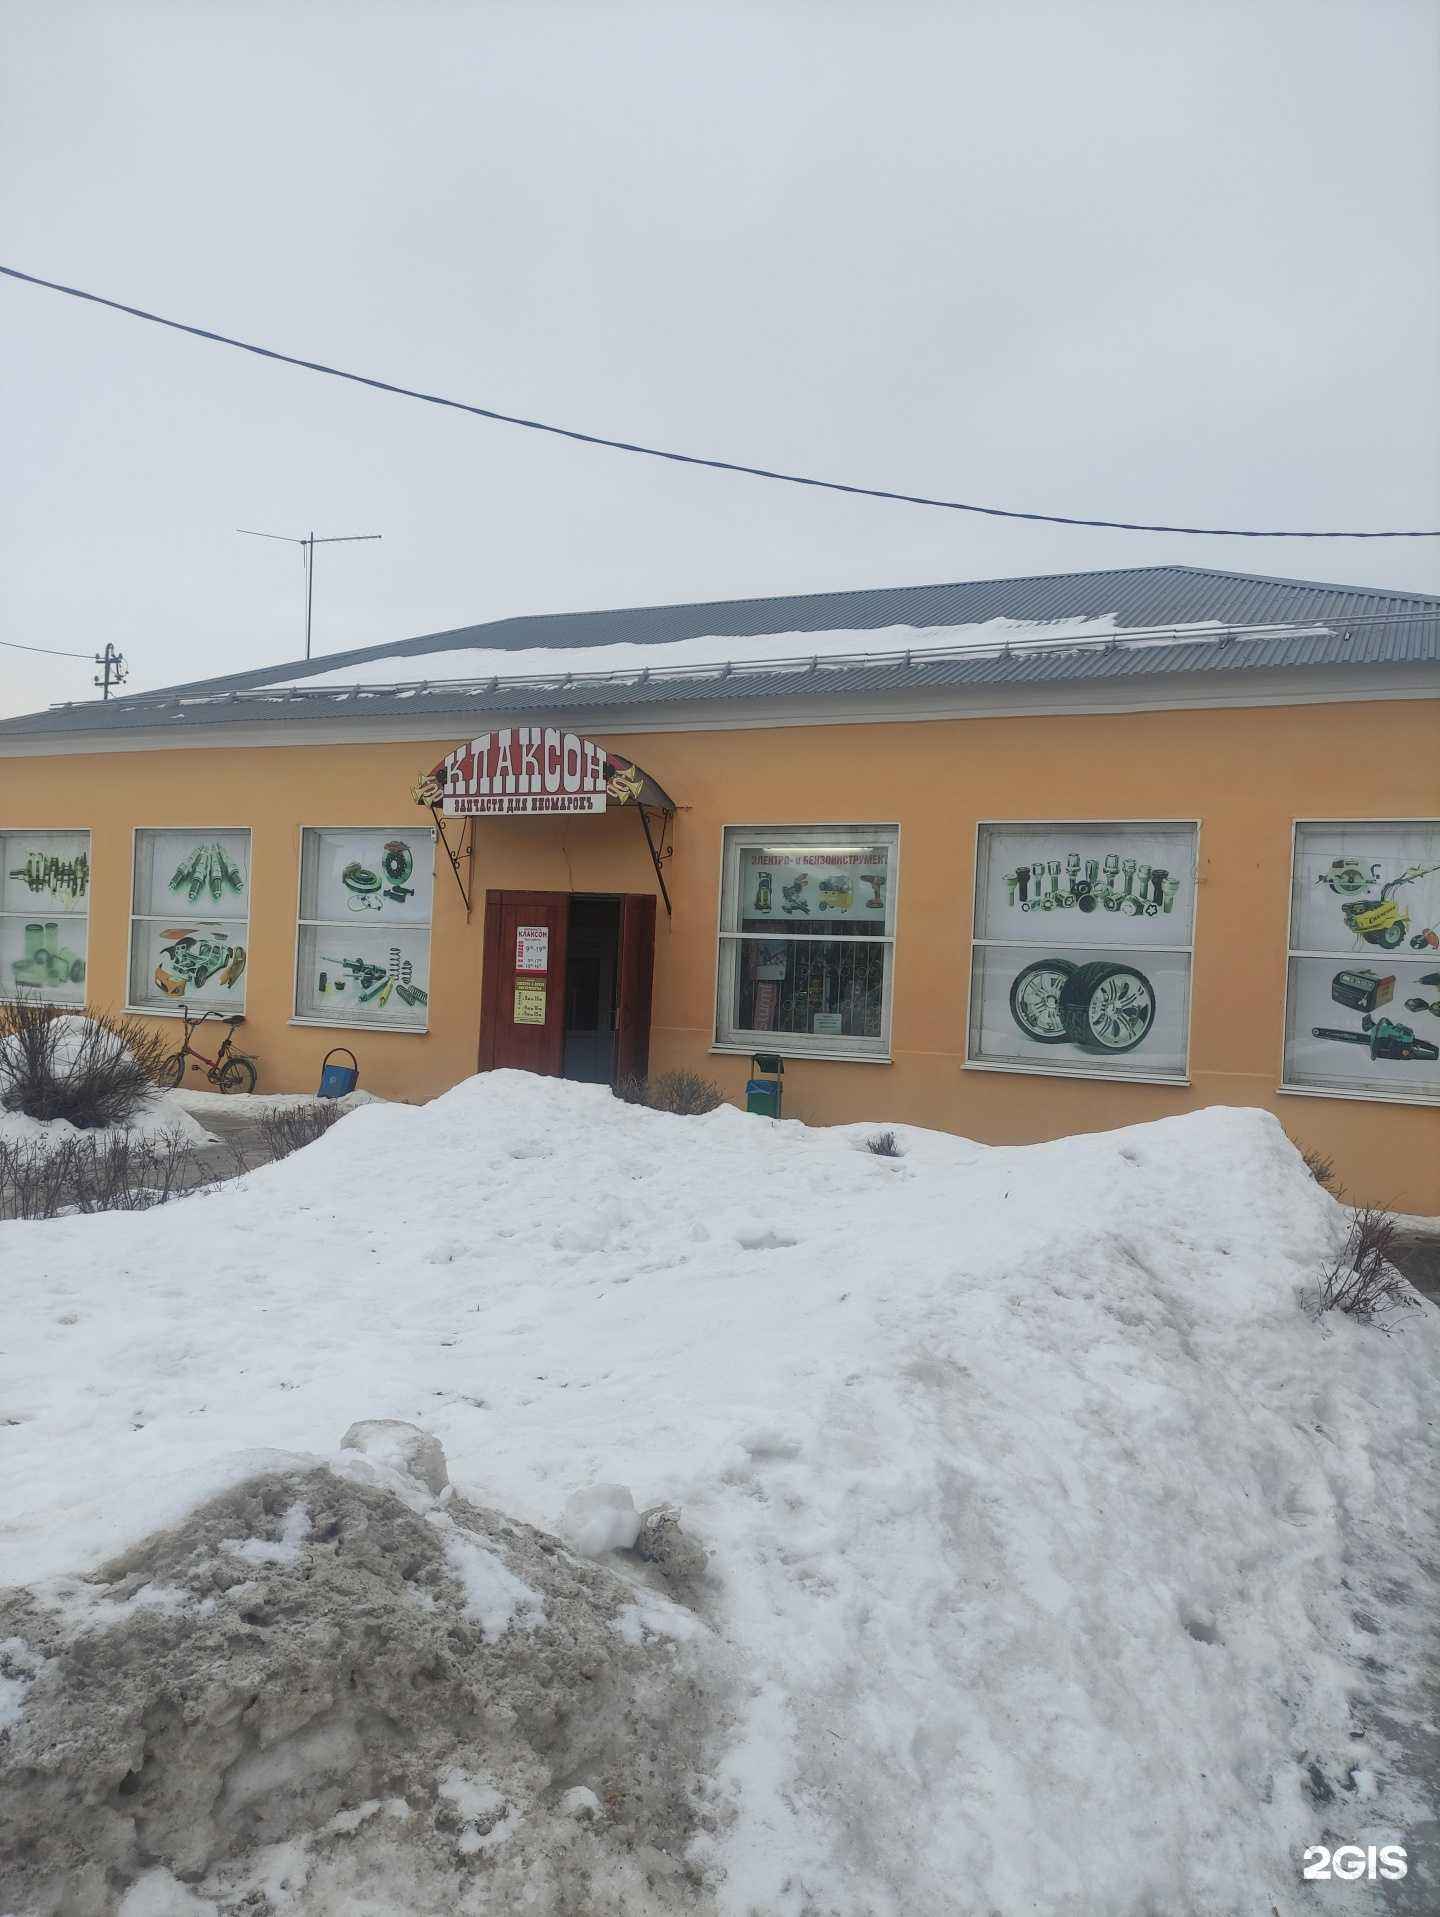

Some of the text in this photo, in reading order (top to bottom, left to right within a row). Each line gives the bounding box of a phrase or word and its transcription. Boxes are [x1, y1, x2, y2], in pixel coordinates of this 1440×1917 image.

[444, 727, 607, 795] КЛАКСОН
[454, 798, 504, 812] ЗАПЧАСТИ
[506, 797, 528, 813] ДЛЯ
